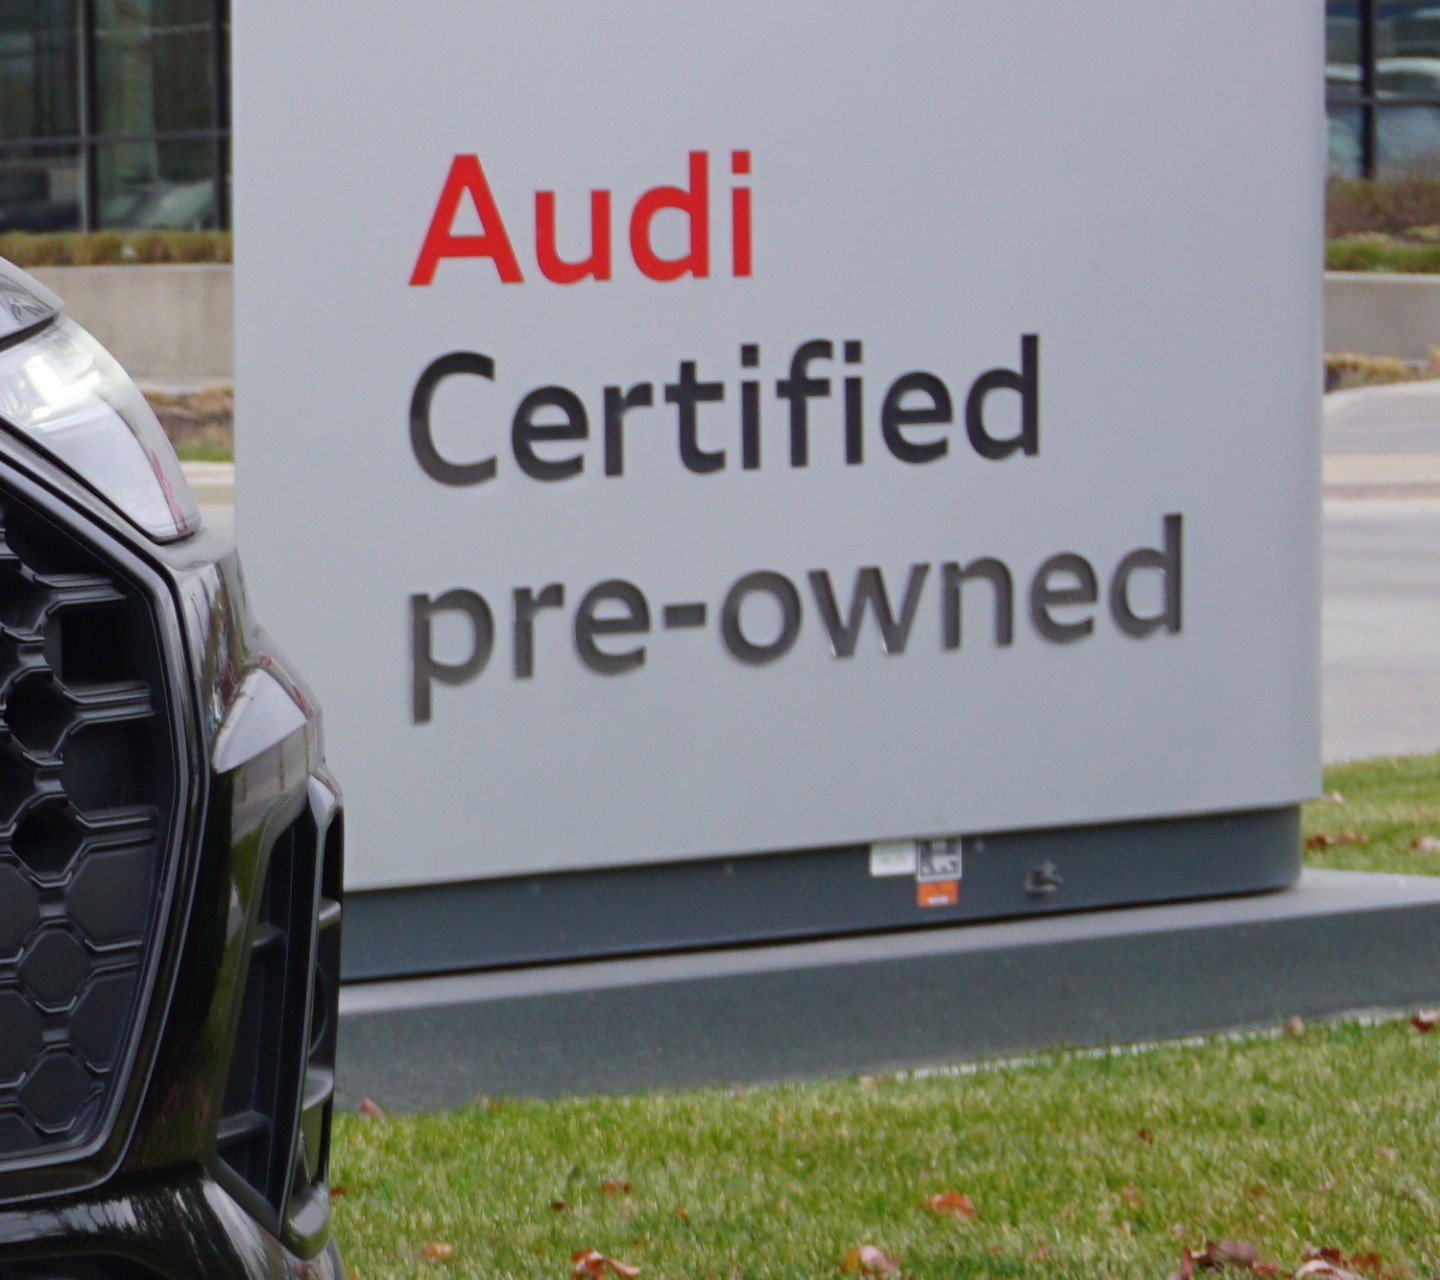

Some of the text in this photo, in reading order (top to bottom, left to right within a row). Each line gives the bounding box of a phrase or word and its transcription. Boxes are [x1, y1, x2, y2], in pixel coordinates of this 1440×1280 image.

[409, 150, 752, 287] Audi
[408, 332, 1041, 488] Certified
[408, 512, 1185, 726] pre-owned
